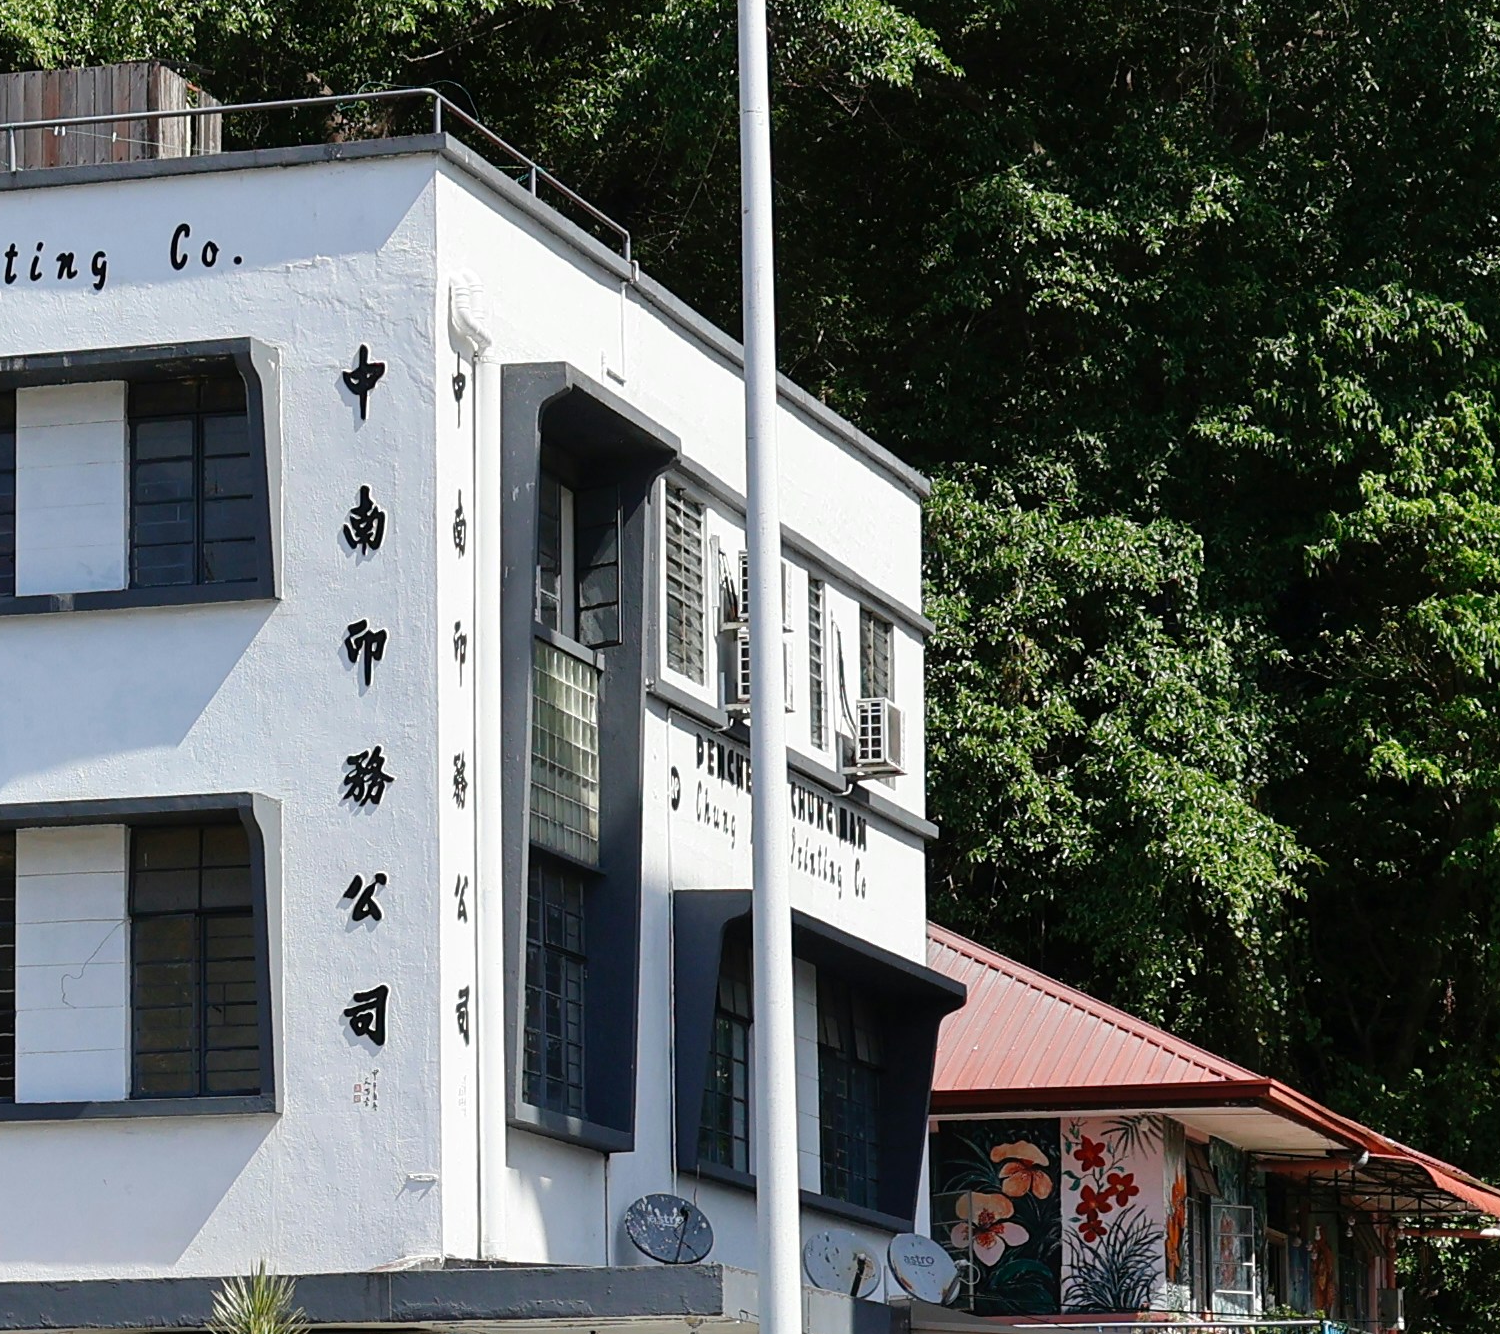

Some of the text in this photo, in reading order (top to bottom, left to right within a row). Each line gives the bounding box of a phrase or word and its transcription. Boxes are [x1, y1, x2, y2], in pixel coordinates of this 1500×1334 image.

[170, 223, 243, 271] Co.
[342, 343, 395, 1046] 中南印務公司
[452, 351, 470, 1047] 中南印務公司
[696, 732, 752, 796] PENCHE
[696, 780, 736, 850] Chung
[903, 1253, 935, 1266] astro
